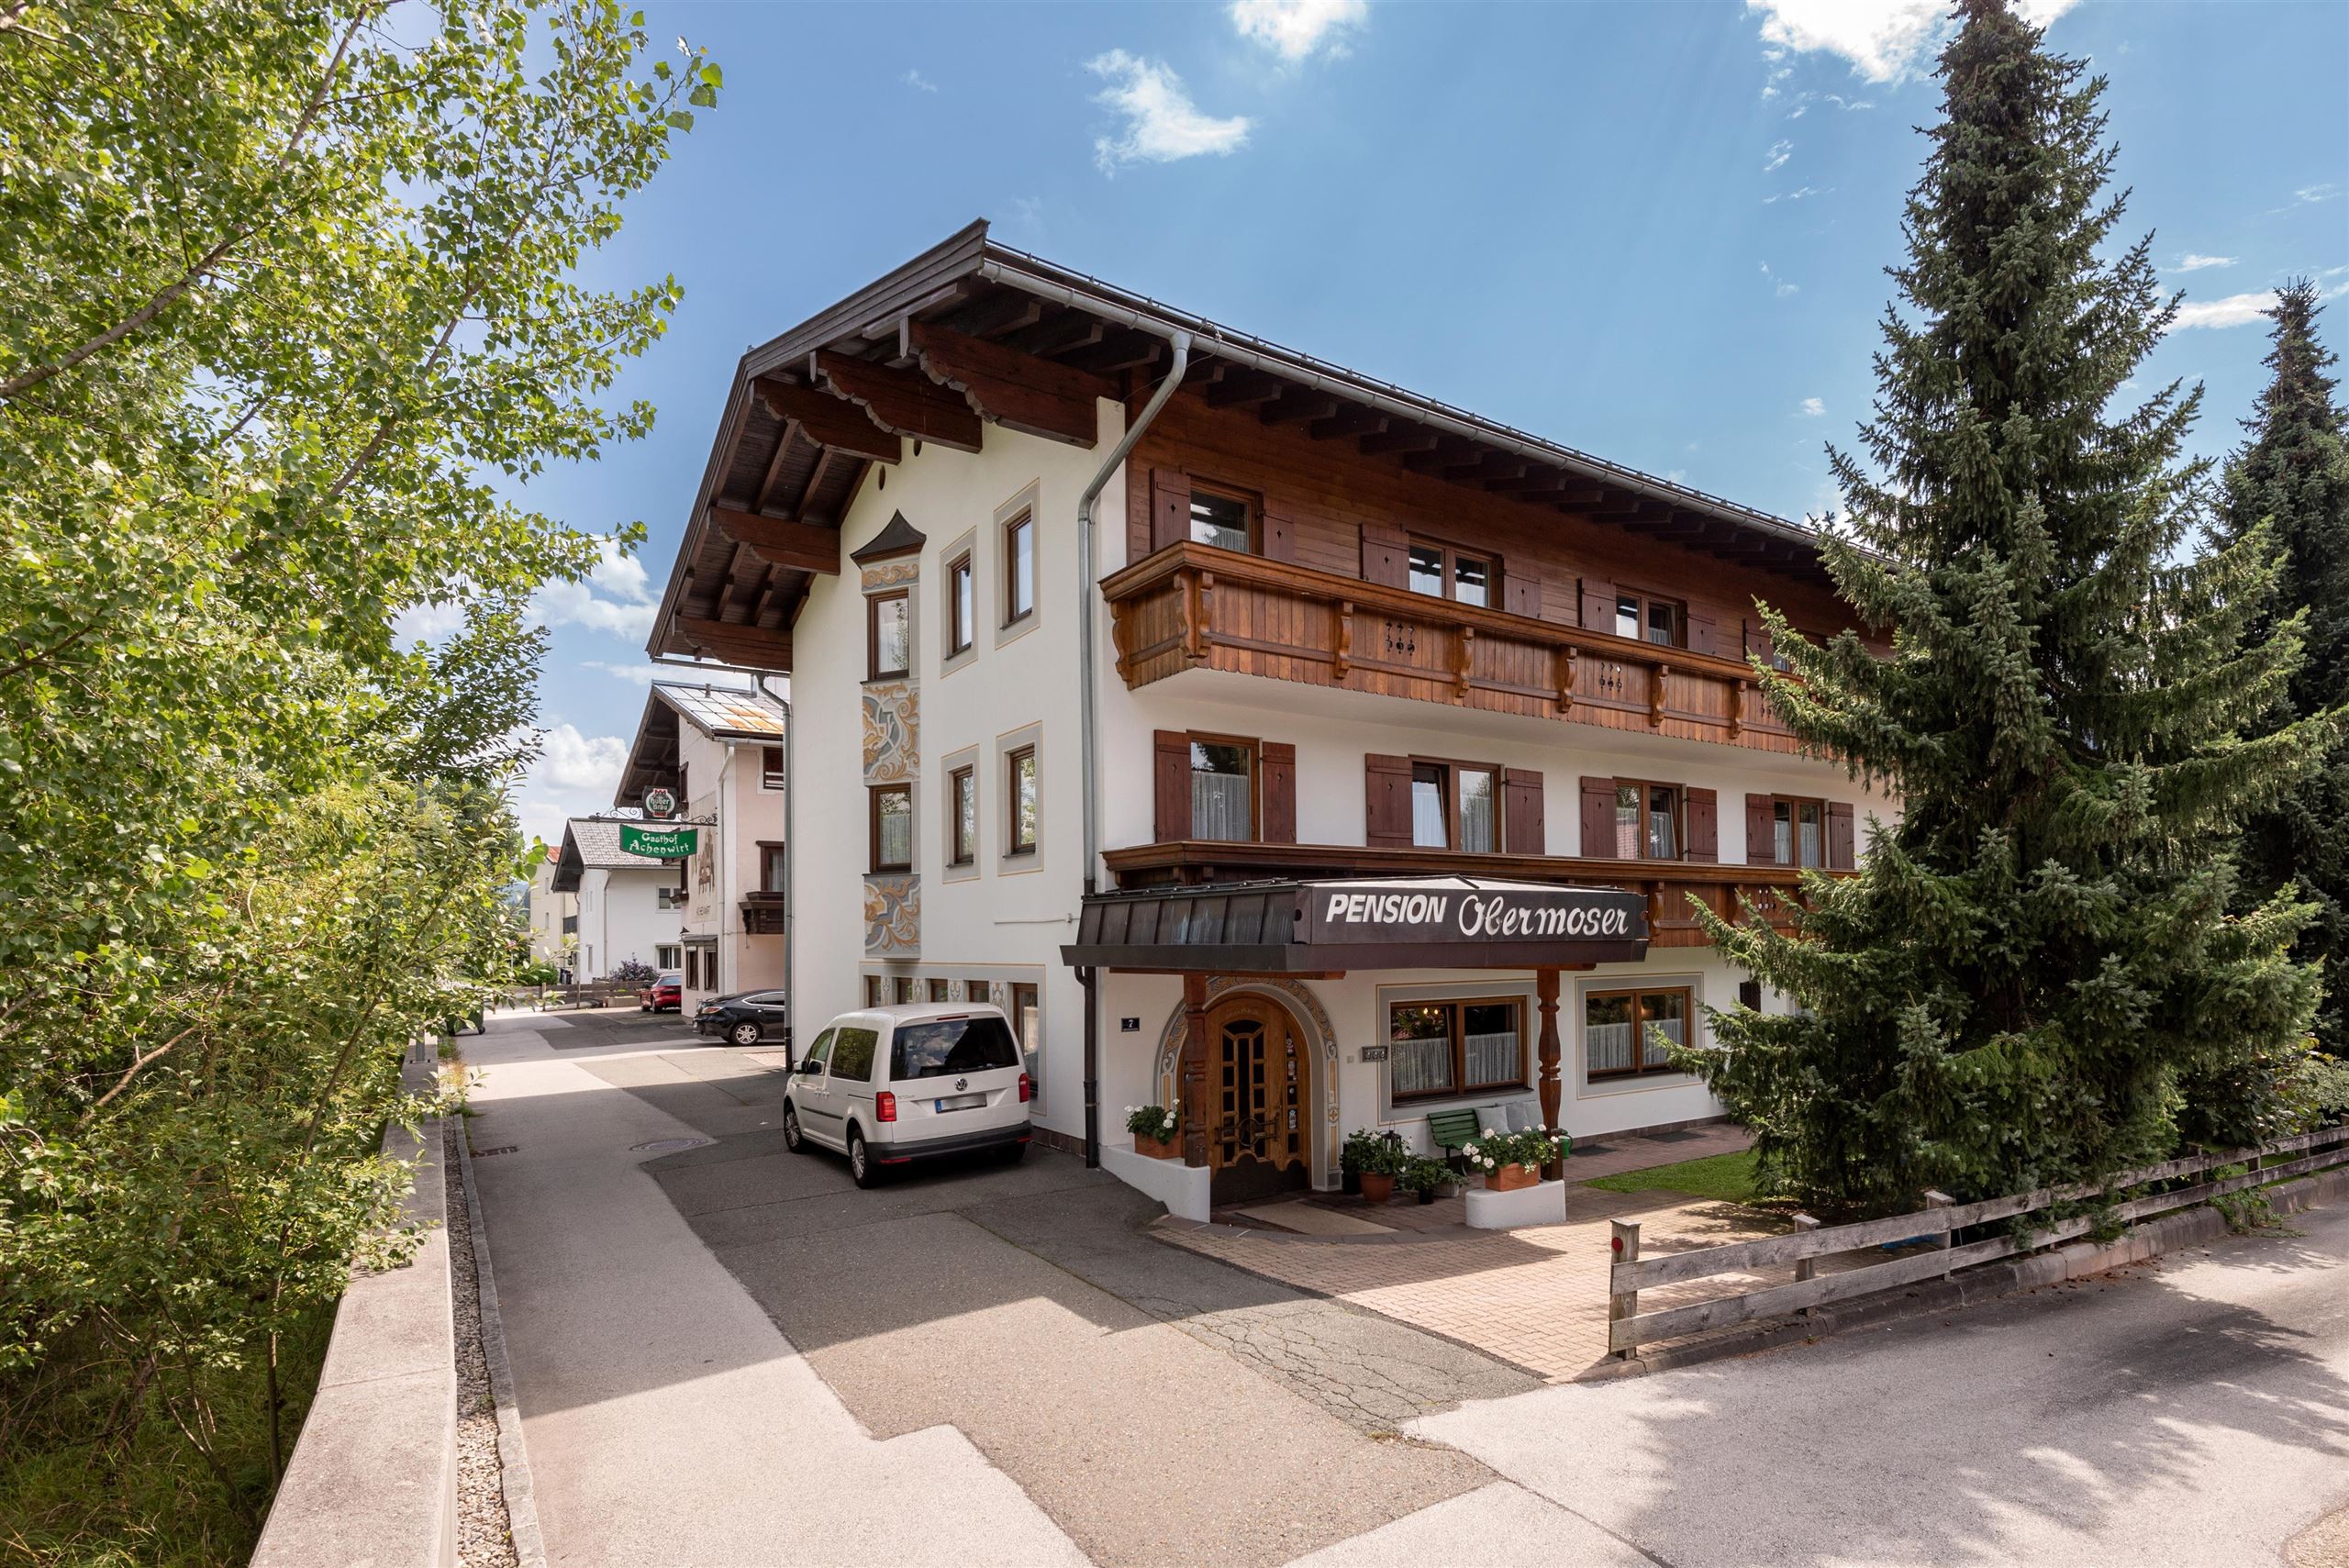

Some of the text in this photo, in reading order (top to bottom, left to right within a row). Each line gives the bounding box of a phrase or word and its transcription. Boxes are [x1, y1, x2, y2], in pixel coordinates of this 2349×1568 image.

[641, 833, 678, 844] Gasthof
[629, 840, 689, 854] Achenwirt
[1326, 895, 1629, 937] PENSION Obermoser
